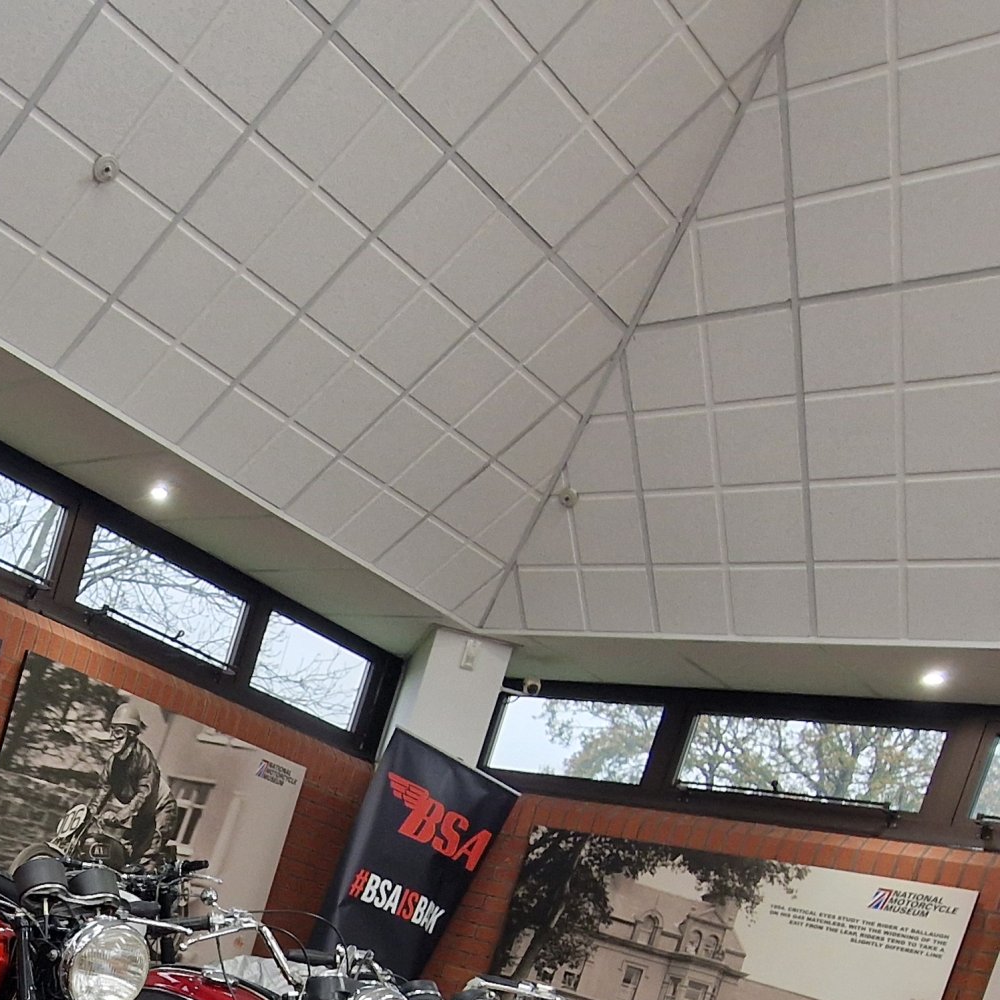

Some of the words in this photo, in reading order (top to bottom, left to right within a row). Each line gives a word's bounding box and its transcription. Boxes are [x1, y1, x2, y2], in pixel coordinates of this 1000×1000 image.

[397, 788, 493, 872] BSA
[889, 897, 960, 915] MOTORCYCLE
[893, 890, 944, 904] NATIONAL
[787, 906, 817, 916] CRITICAL
[818, 912, 836, 920] EYES
[837, 915, 860, 924] STUDY
[876, 922, 898, 930] RIDER
[883, 905, 930, 918] MUSEUM
[805, 922, 824, 930] FROM
[859, 933, 885, 941] RIDERS
[887, 937, 906, 945] TEND
[919, 943, 939, 951] TAKE
[883, 931, 919, 941] WIDENING
[850, 937, 884, 948] SLIGHTLY
[885, 944, 924, 956] DIFFERENT
[925, 950, 943, 959] LINE
